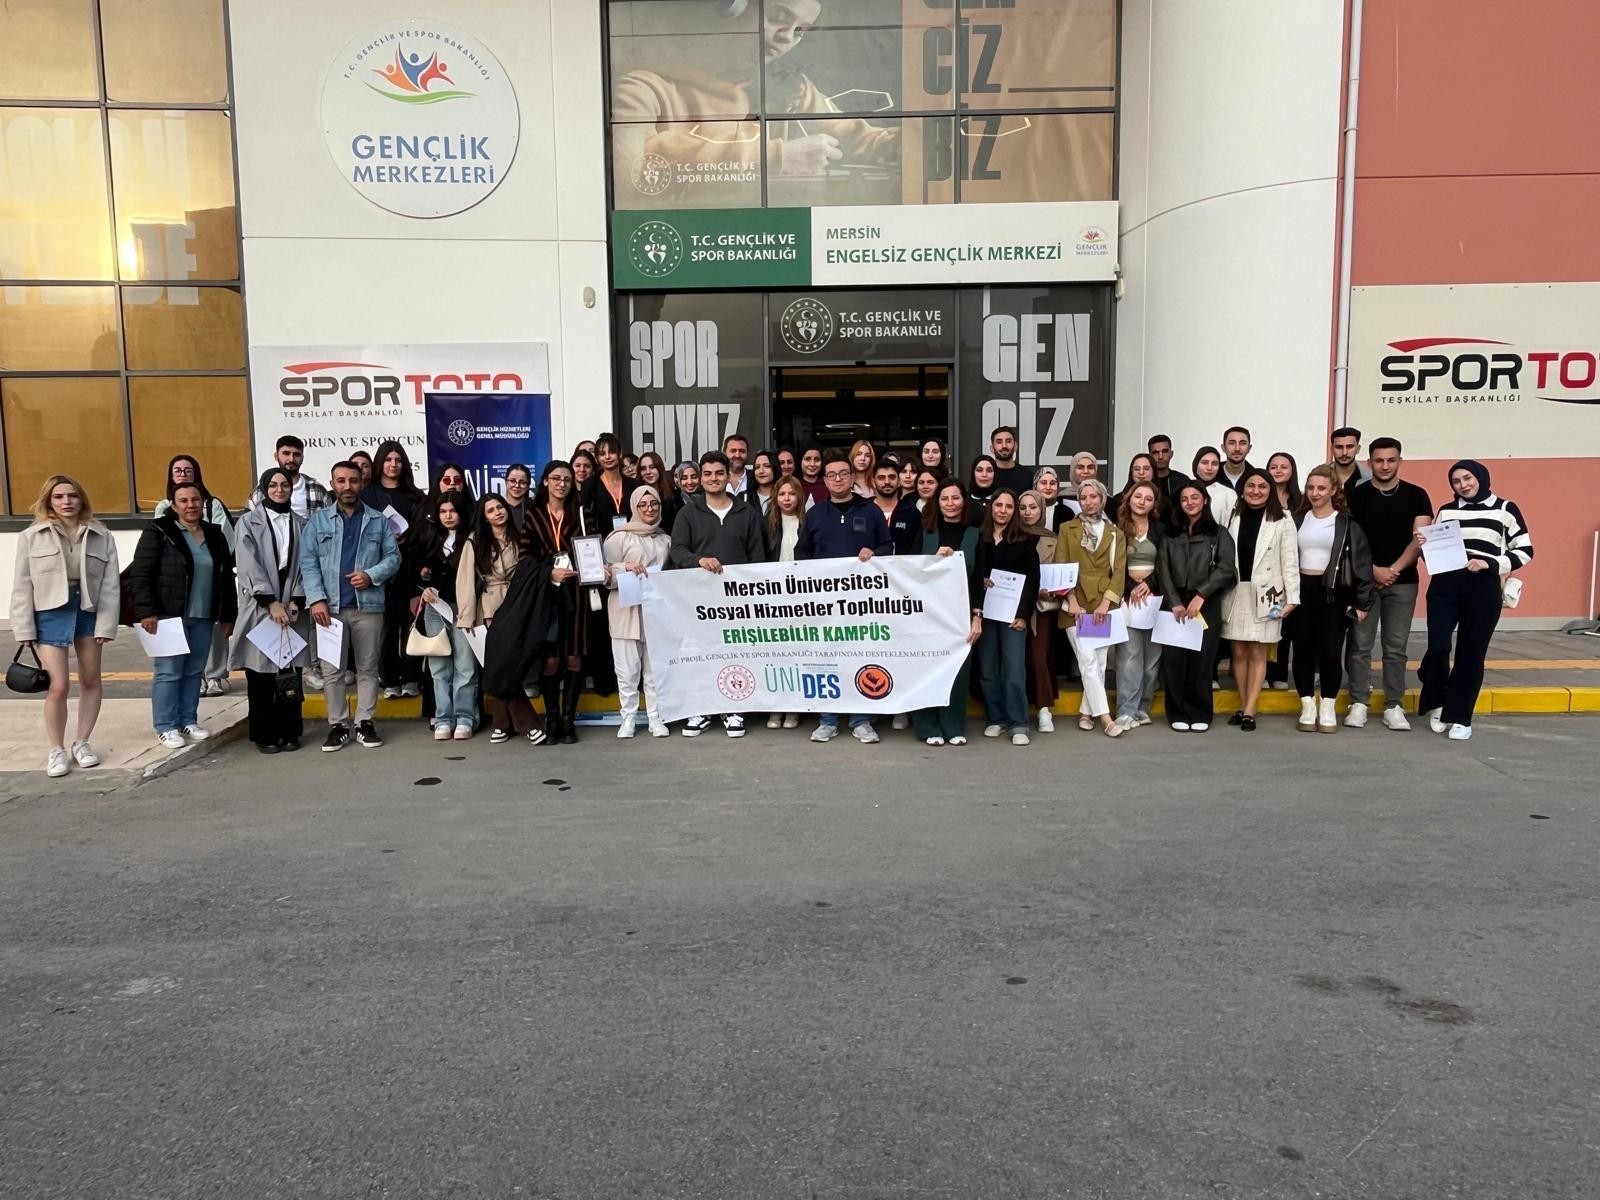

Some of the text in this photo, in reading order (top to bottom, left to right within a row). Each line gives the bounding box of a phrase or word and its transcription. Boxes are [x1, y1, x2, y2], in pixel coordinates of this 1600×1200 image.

[357, 33, 396, 61] GENÇLİK
[399, 30, 411, 38] VE
[414, 30, 441, 40] SPOR
[351, 134, 491, 162] GENÇLİK
[353, 165, 495, 184] MERKEZLERİ
[676, 160, 756, 174] T.C. GENÇLİK VE
[676, 172, 756, 183] SPOR BAKANLIĞI
[691, 232, 796, 248] T.C. GENÇLİK VE
[826, 225, 882, 240] MERSİN
[691, 247, 796, 262] SPOR BAKANLIĞI
[826, 242, 1062, 266] ENGELSİZ GENÇLİK MERKEZİ
[839, 308, 942, 324] T.C. GENÇLİK VE
[839, 323, 942, 338] SPOR BAKANLIĞI
[629, 320, 719, 389] SPOR
[982, 313, 1091, 383] GEN
[1381, 394, 1521, 404] TEŞKİLAT BAŞKANLIĞI
[283, 409, 404, 419] TEŞKİLAT BAŞKANLIĞI
[340, 437, 359, 447] VE
[723, 572, 889, 597] Mersin Üniversitesi
[696, 595, 924, 620] Sosyal Hizmetler Topluluğu
[723, 622, 891, 646] ERİŞİLEBİLİR KAMPÜS
[705, 651, 739, 661] GENÇLİK
[752, 651, 770, 659] SPOR
[772, 649, 812, 658] BAKANLIĞI
[814, 650, 863, 658] TARAFINDAN
